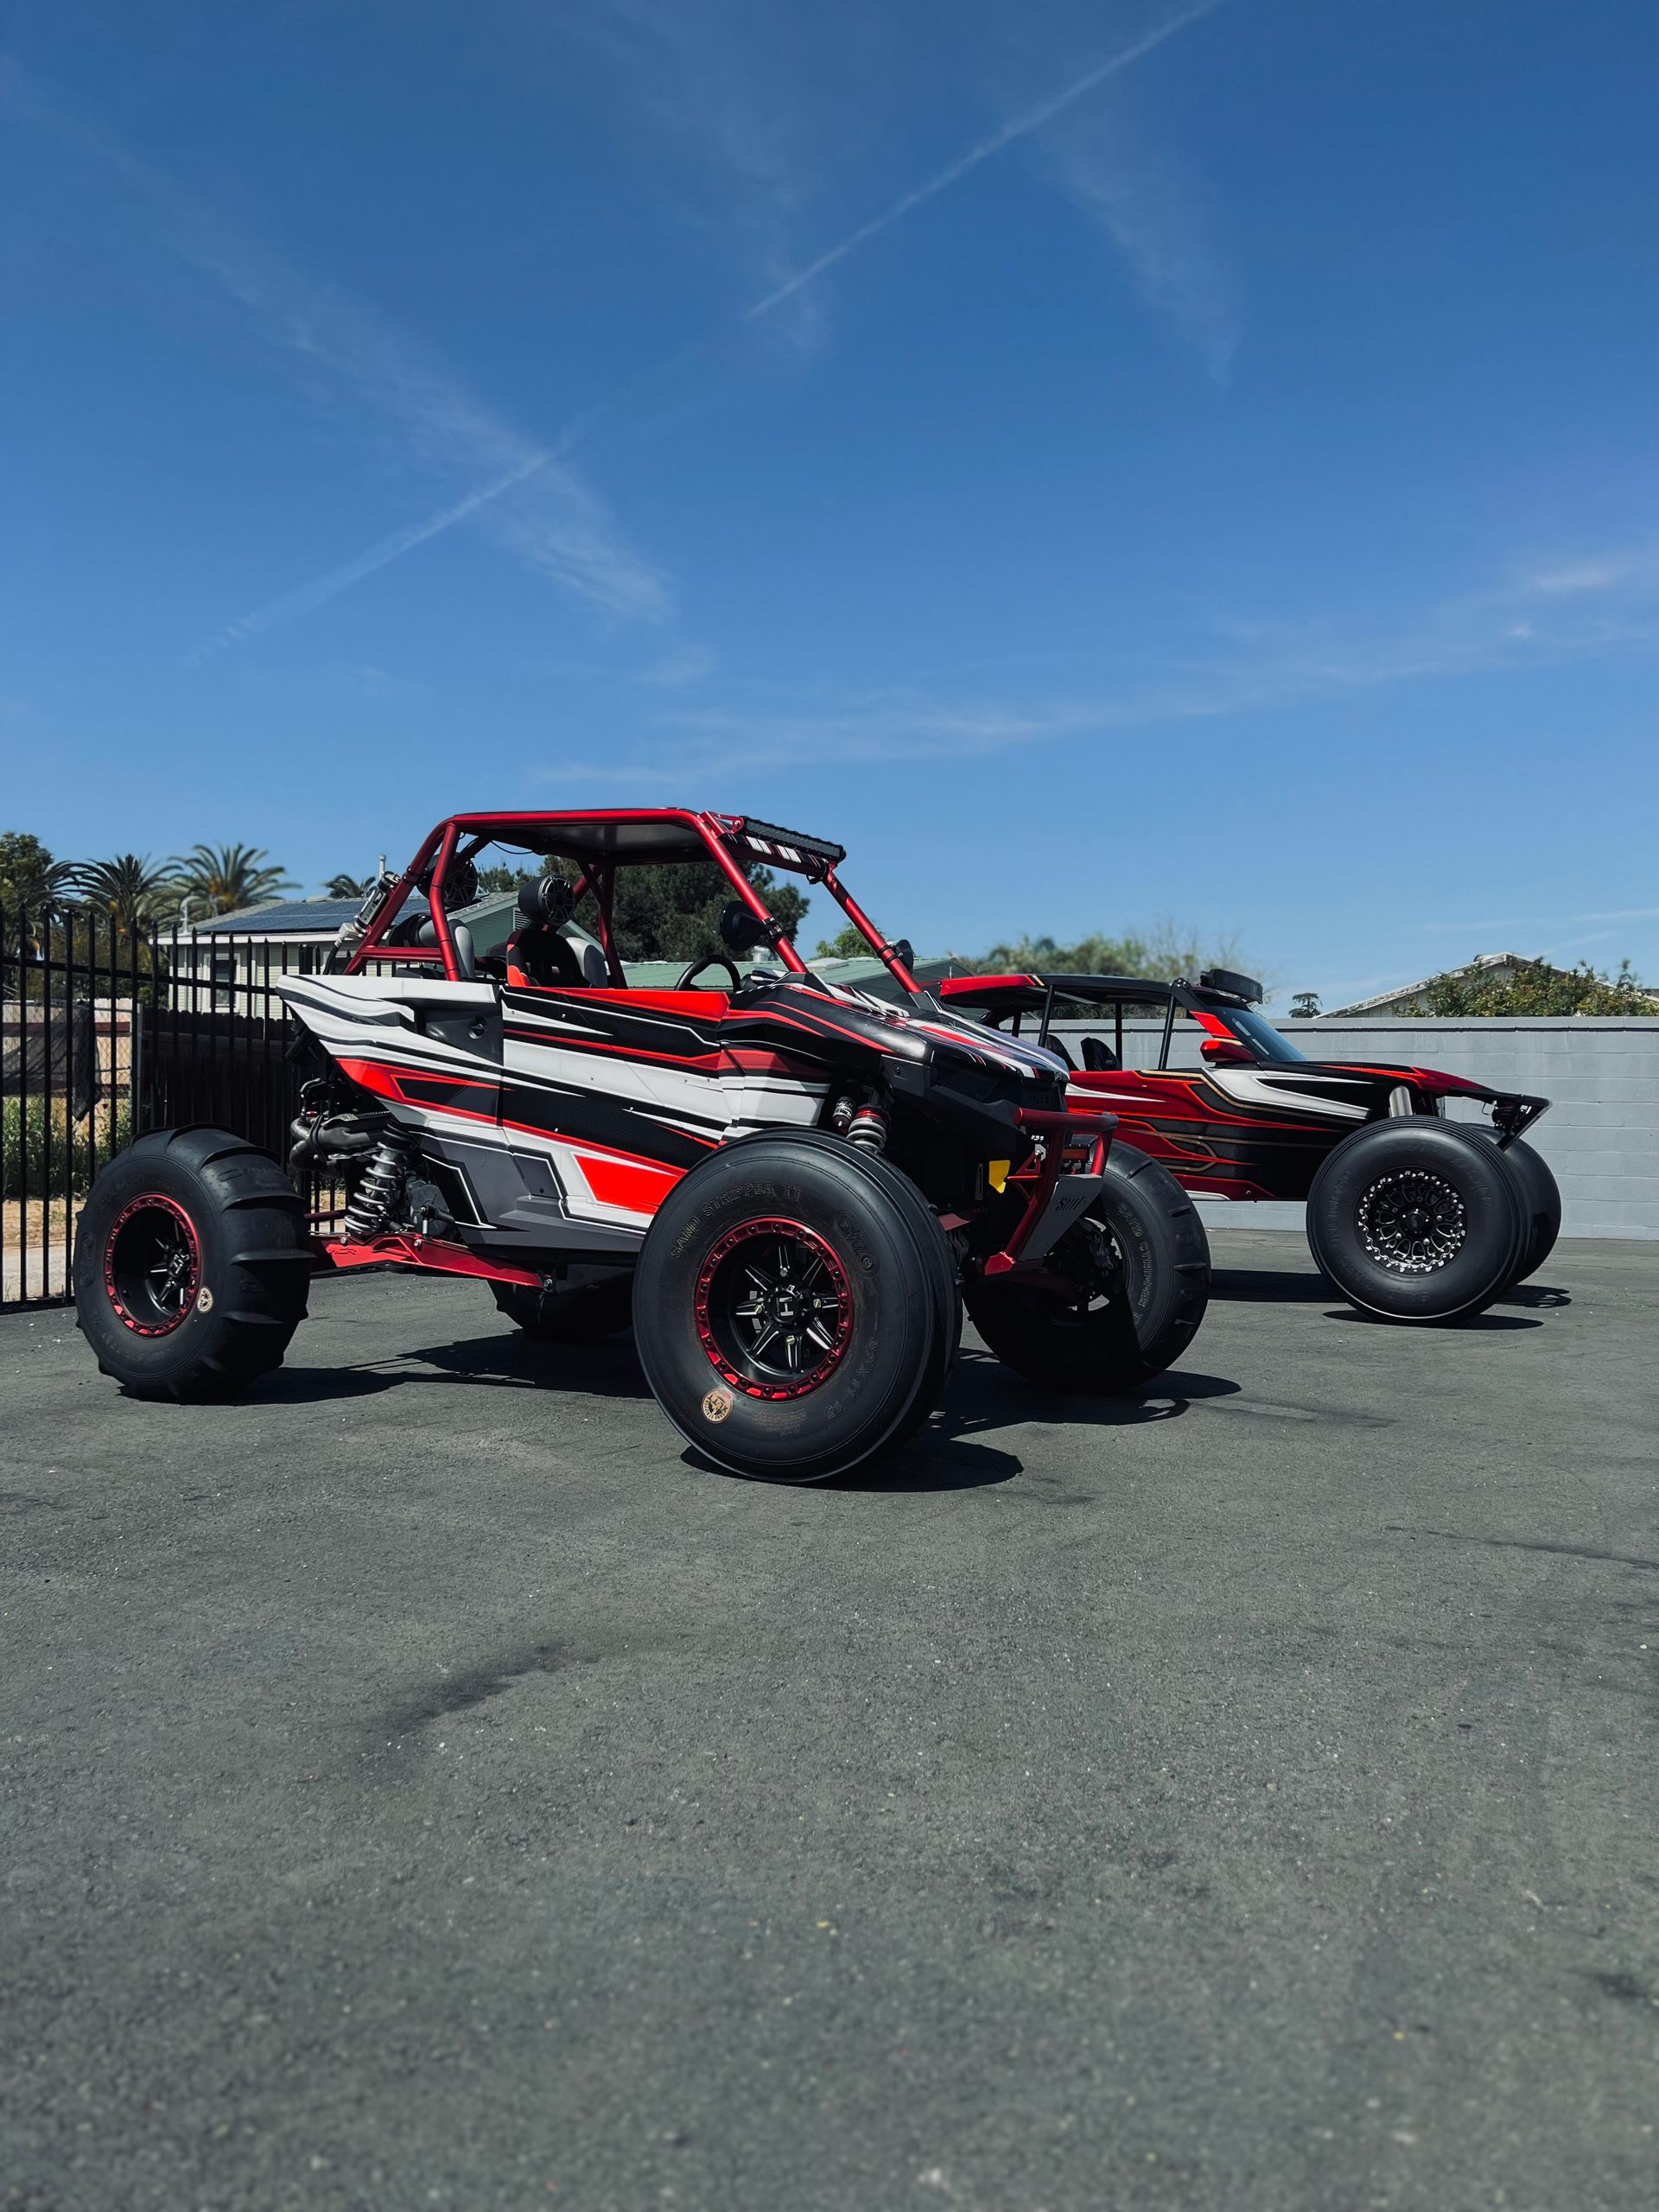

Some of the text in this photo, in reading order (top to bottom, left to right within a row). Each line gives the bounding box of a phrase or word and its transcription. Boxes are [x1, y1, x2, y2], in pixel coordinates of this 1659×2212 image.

[1404, 1169, 1465, 1211] RACING
[670, 1181, 802, 1259] SAND STRIPPER TT
[1117, 1202, 1143, 1237] SAND
